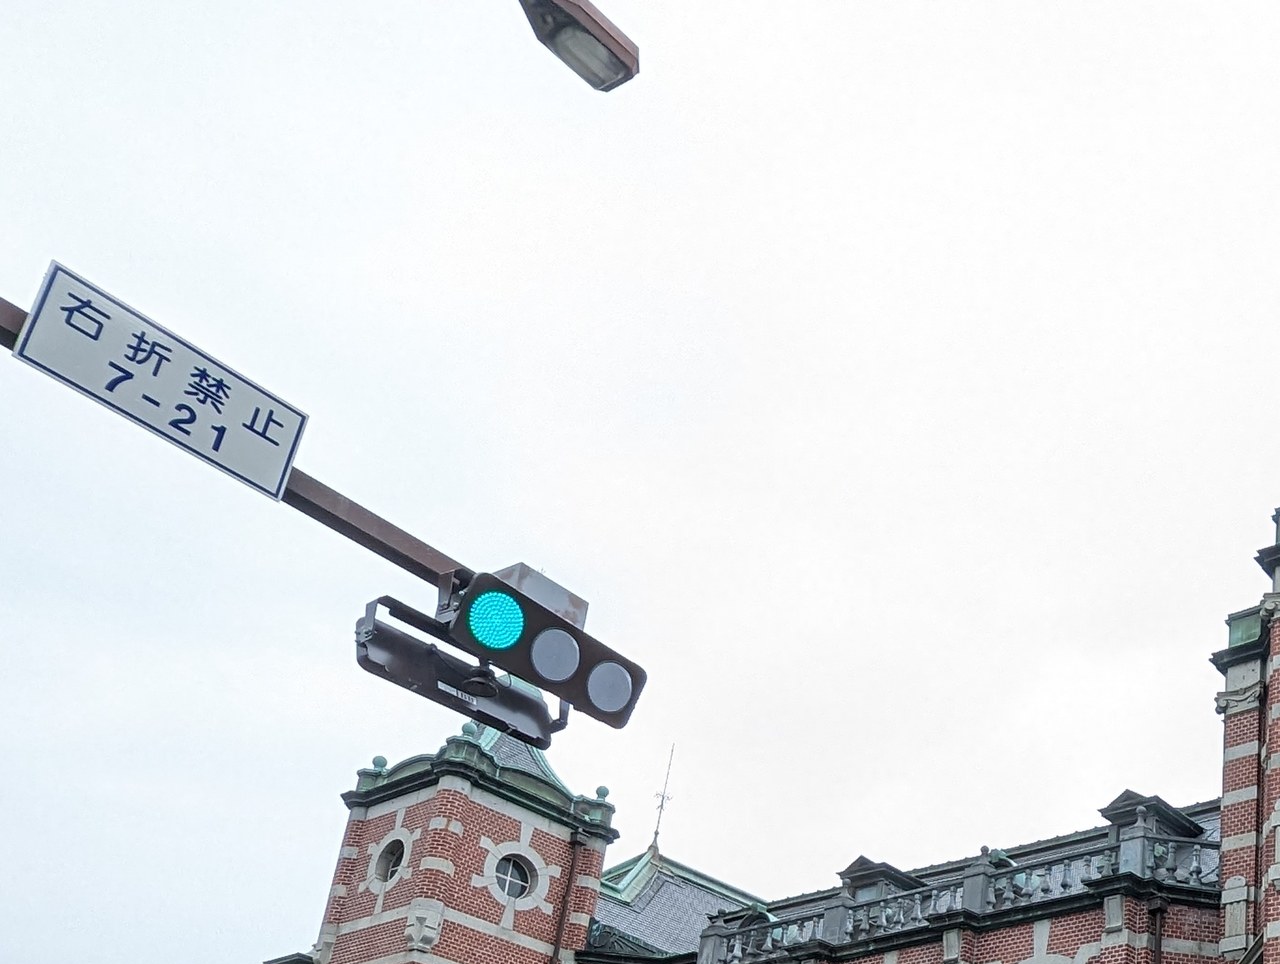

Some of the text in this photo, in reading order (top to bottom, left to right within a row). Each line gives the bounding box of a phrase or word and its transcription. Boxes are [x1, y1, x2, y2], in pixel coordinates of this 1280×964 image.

[60, 291, 284, 447] 右折禁止
[104, 360, 227, 452] 7-21
